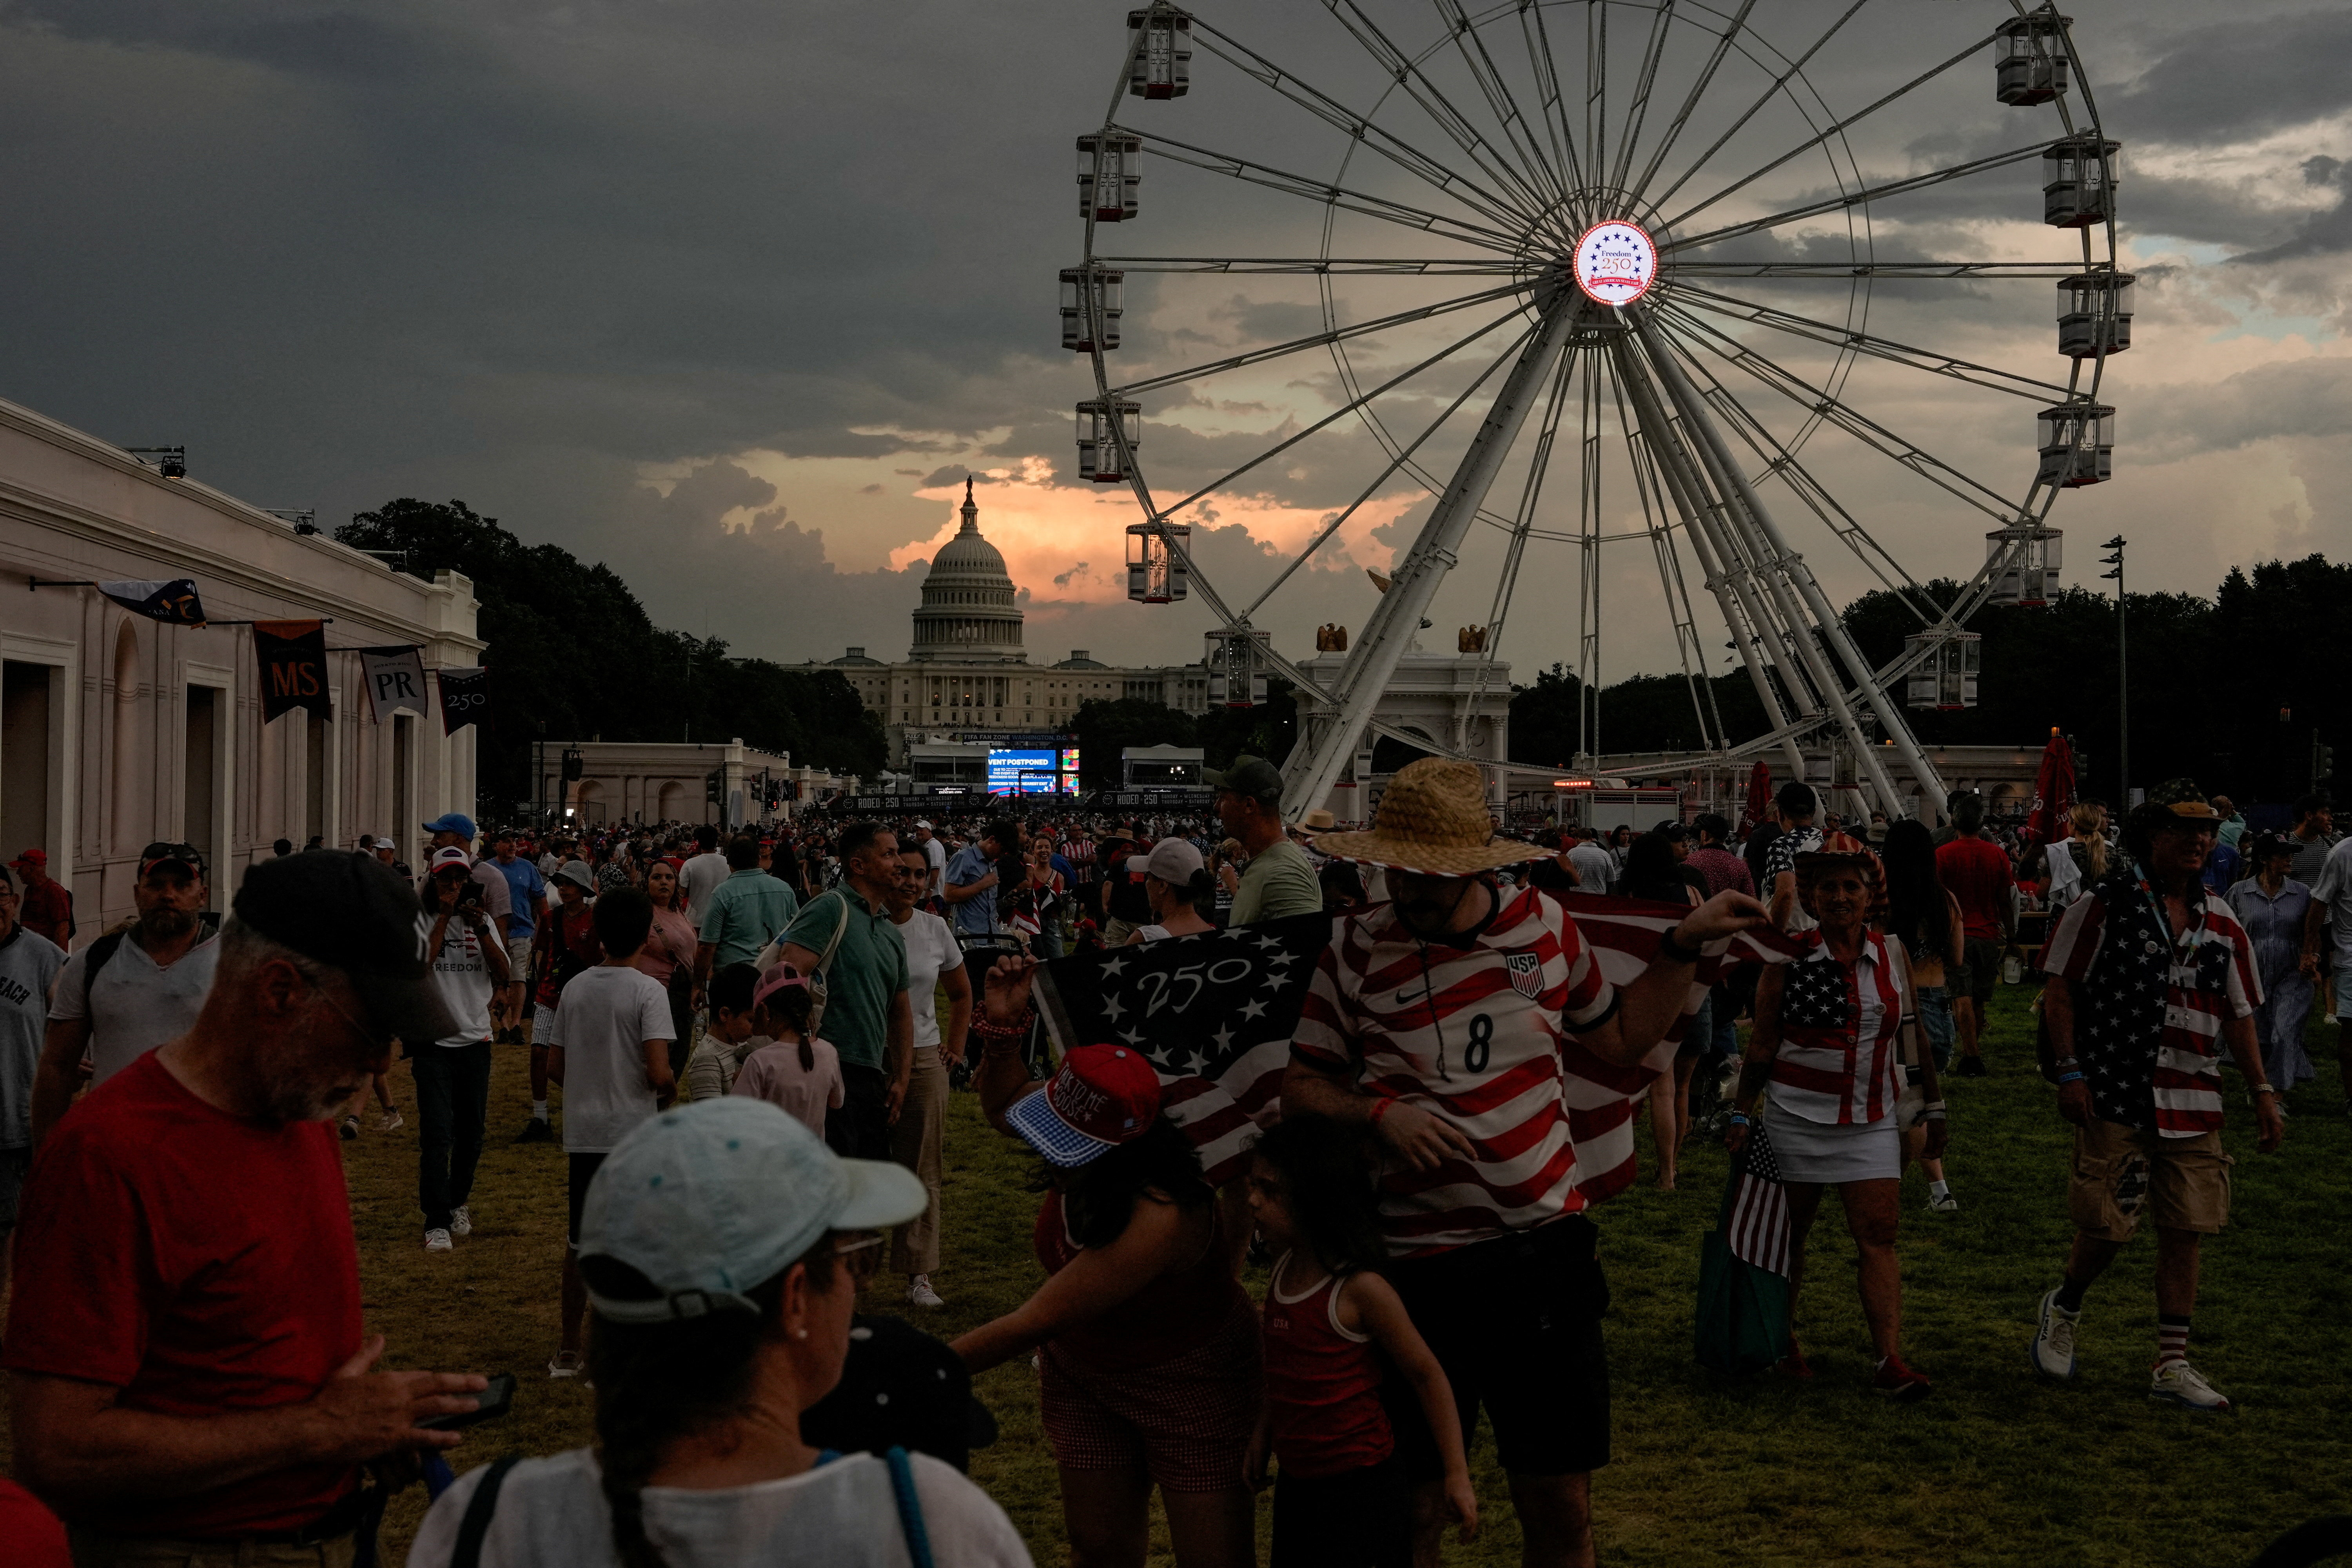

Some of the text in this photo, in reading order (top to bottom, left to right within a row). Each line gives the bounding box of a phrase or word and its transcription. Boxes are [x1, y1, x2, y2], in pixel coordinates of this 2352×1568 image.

[1602, 258, 1631, 274] 250
[270, 662, 319, 697] MS
[376, 672, 417, 701] PR
[448, 694, 485, 710] 250
[858, 797, 899, 808] RODEO 250
[1117, 794, 1158, 805] RODEO 250
[432, 963, 481, 971] REEDOM
[1509, 955, 1537, 973] USA
[1137, 958, 1252, 1018] 250
[1465, 1014, 1493, 1073] 8
[1053, 1085, 1084, 1121] GOOSE
[1071, 1079, 1087, 1100] TO
[1084, 1091, 1109, 1112] ME
